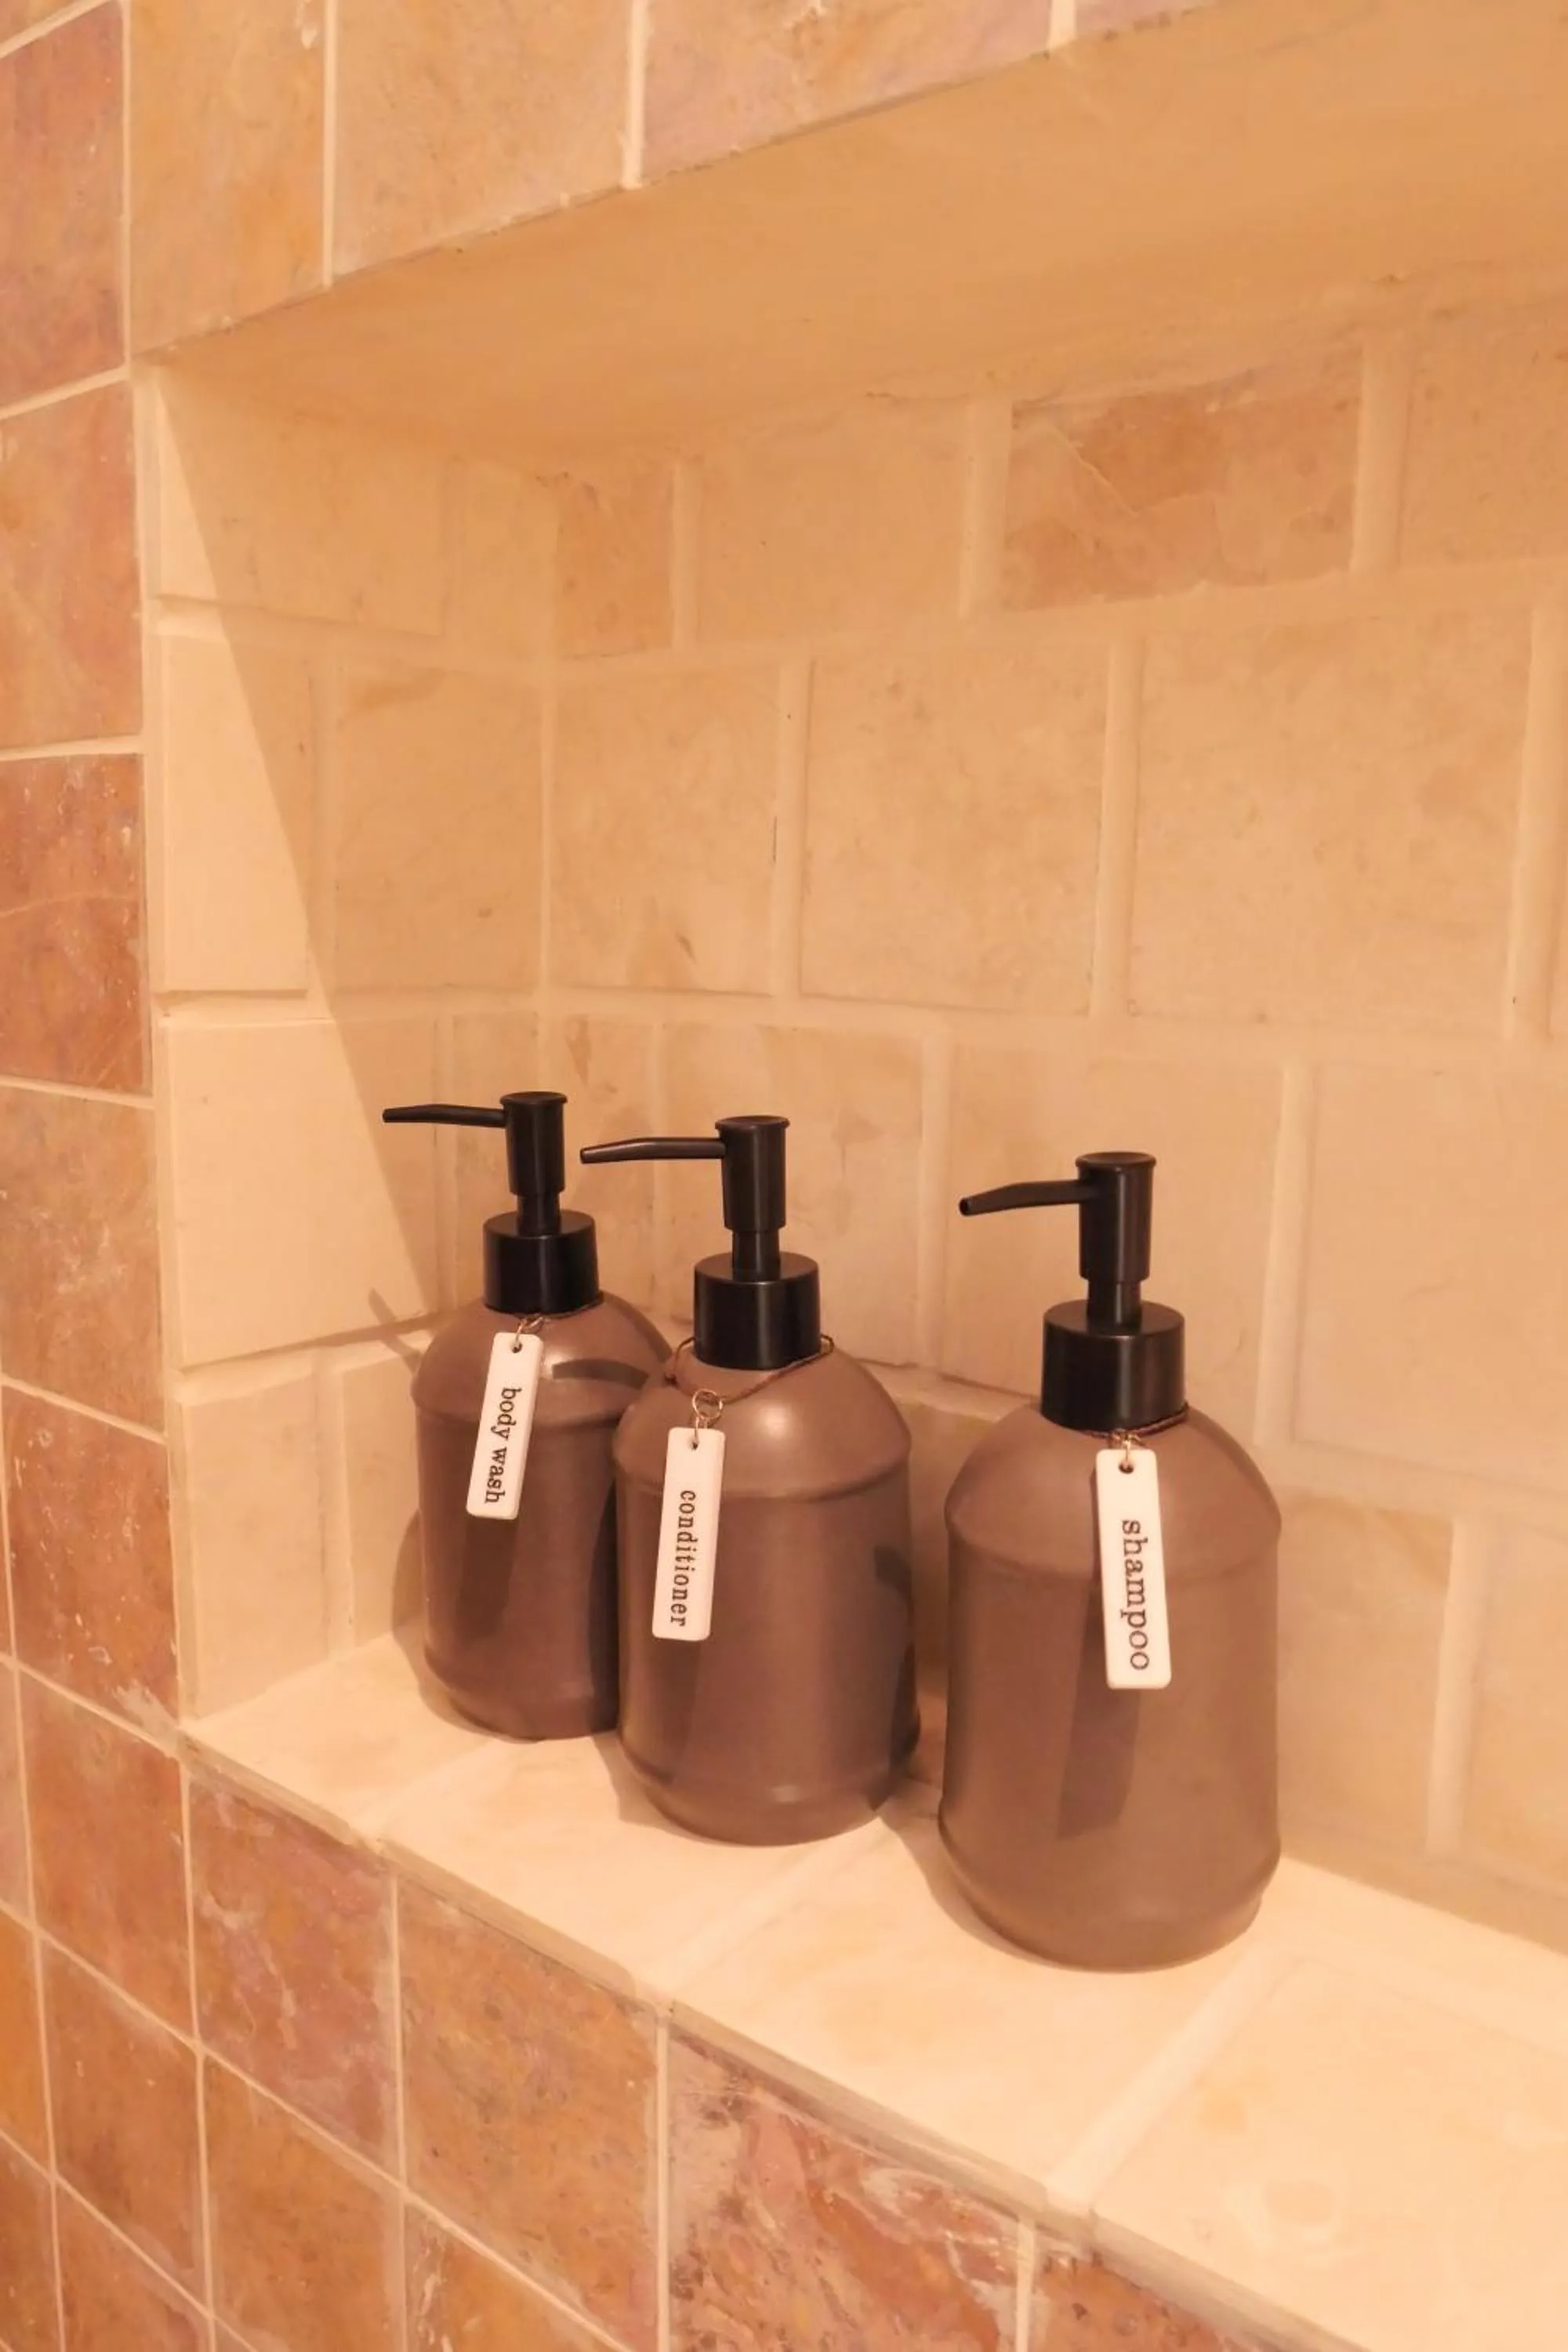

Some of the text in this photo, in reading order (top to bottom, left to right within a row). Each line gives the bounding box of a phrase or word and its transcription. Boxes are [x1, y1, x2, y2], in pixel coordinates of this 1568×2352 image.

[485, 1387, 523, 1504] body wash
[670, 1490, 699, 1628] conditioner
[1120, 1519, 1150, 1671] shampoo
